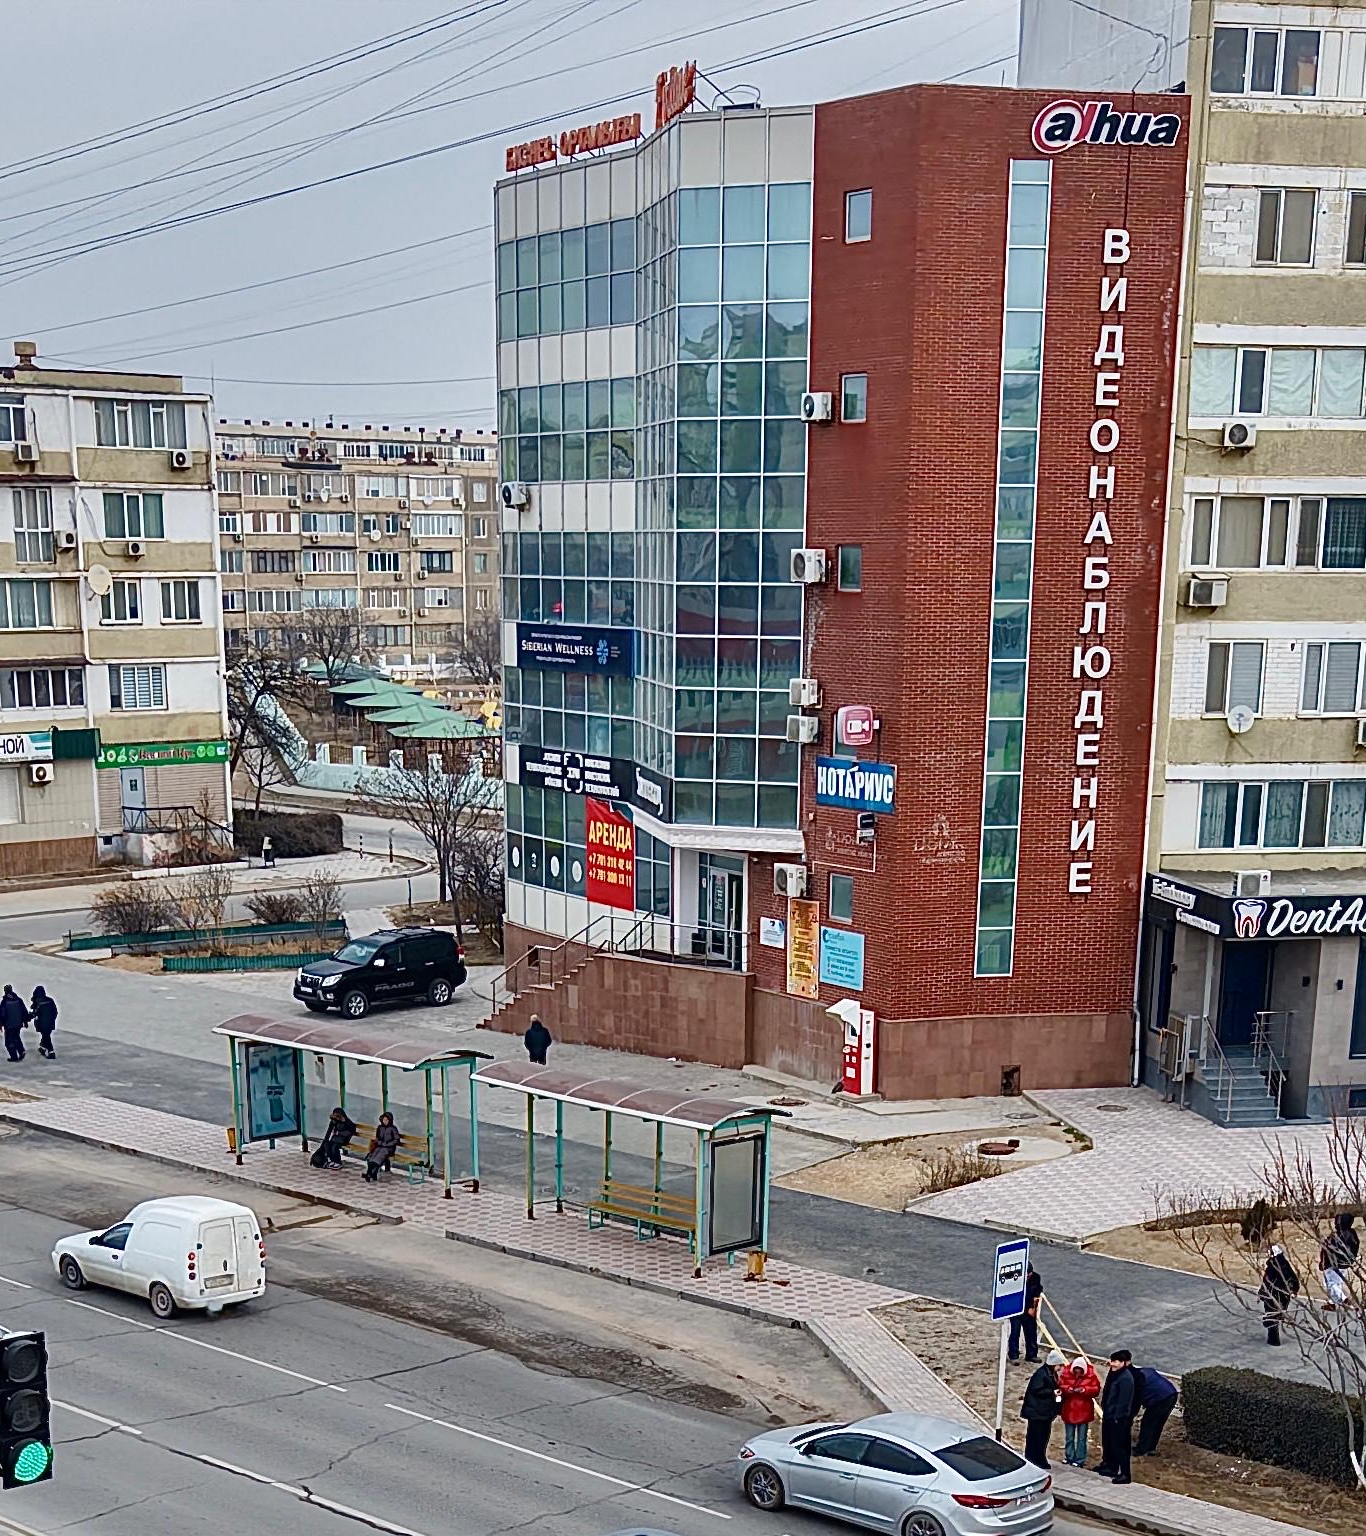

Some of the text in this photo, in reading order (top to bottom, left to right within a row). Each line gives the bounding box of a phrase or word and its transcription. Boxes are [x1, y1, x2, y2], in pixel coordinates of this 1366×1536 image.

[1068, 228, 1132, 894] ВИДЕОНАБЛЮДЕНИЕ
[817, 766, 894, 804] НОТАРИУС
[589, 820, 633, 852] АРЕНДА
[375, 982, 415, 992] PRADO
